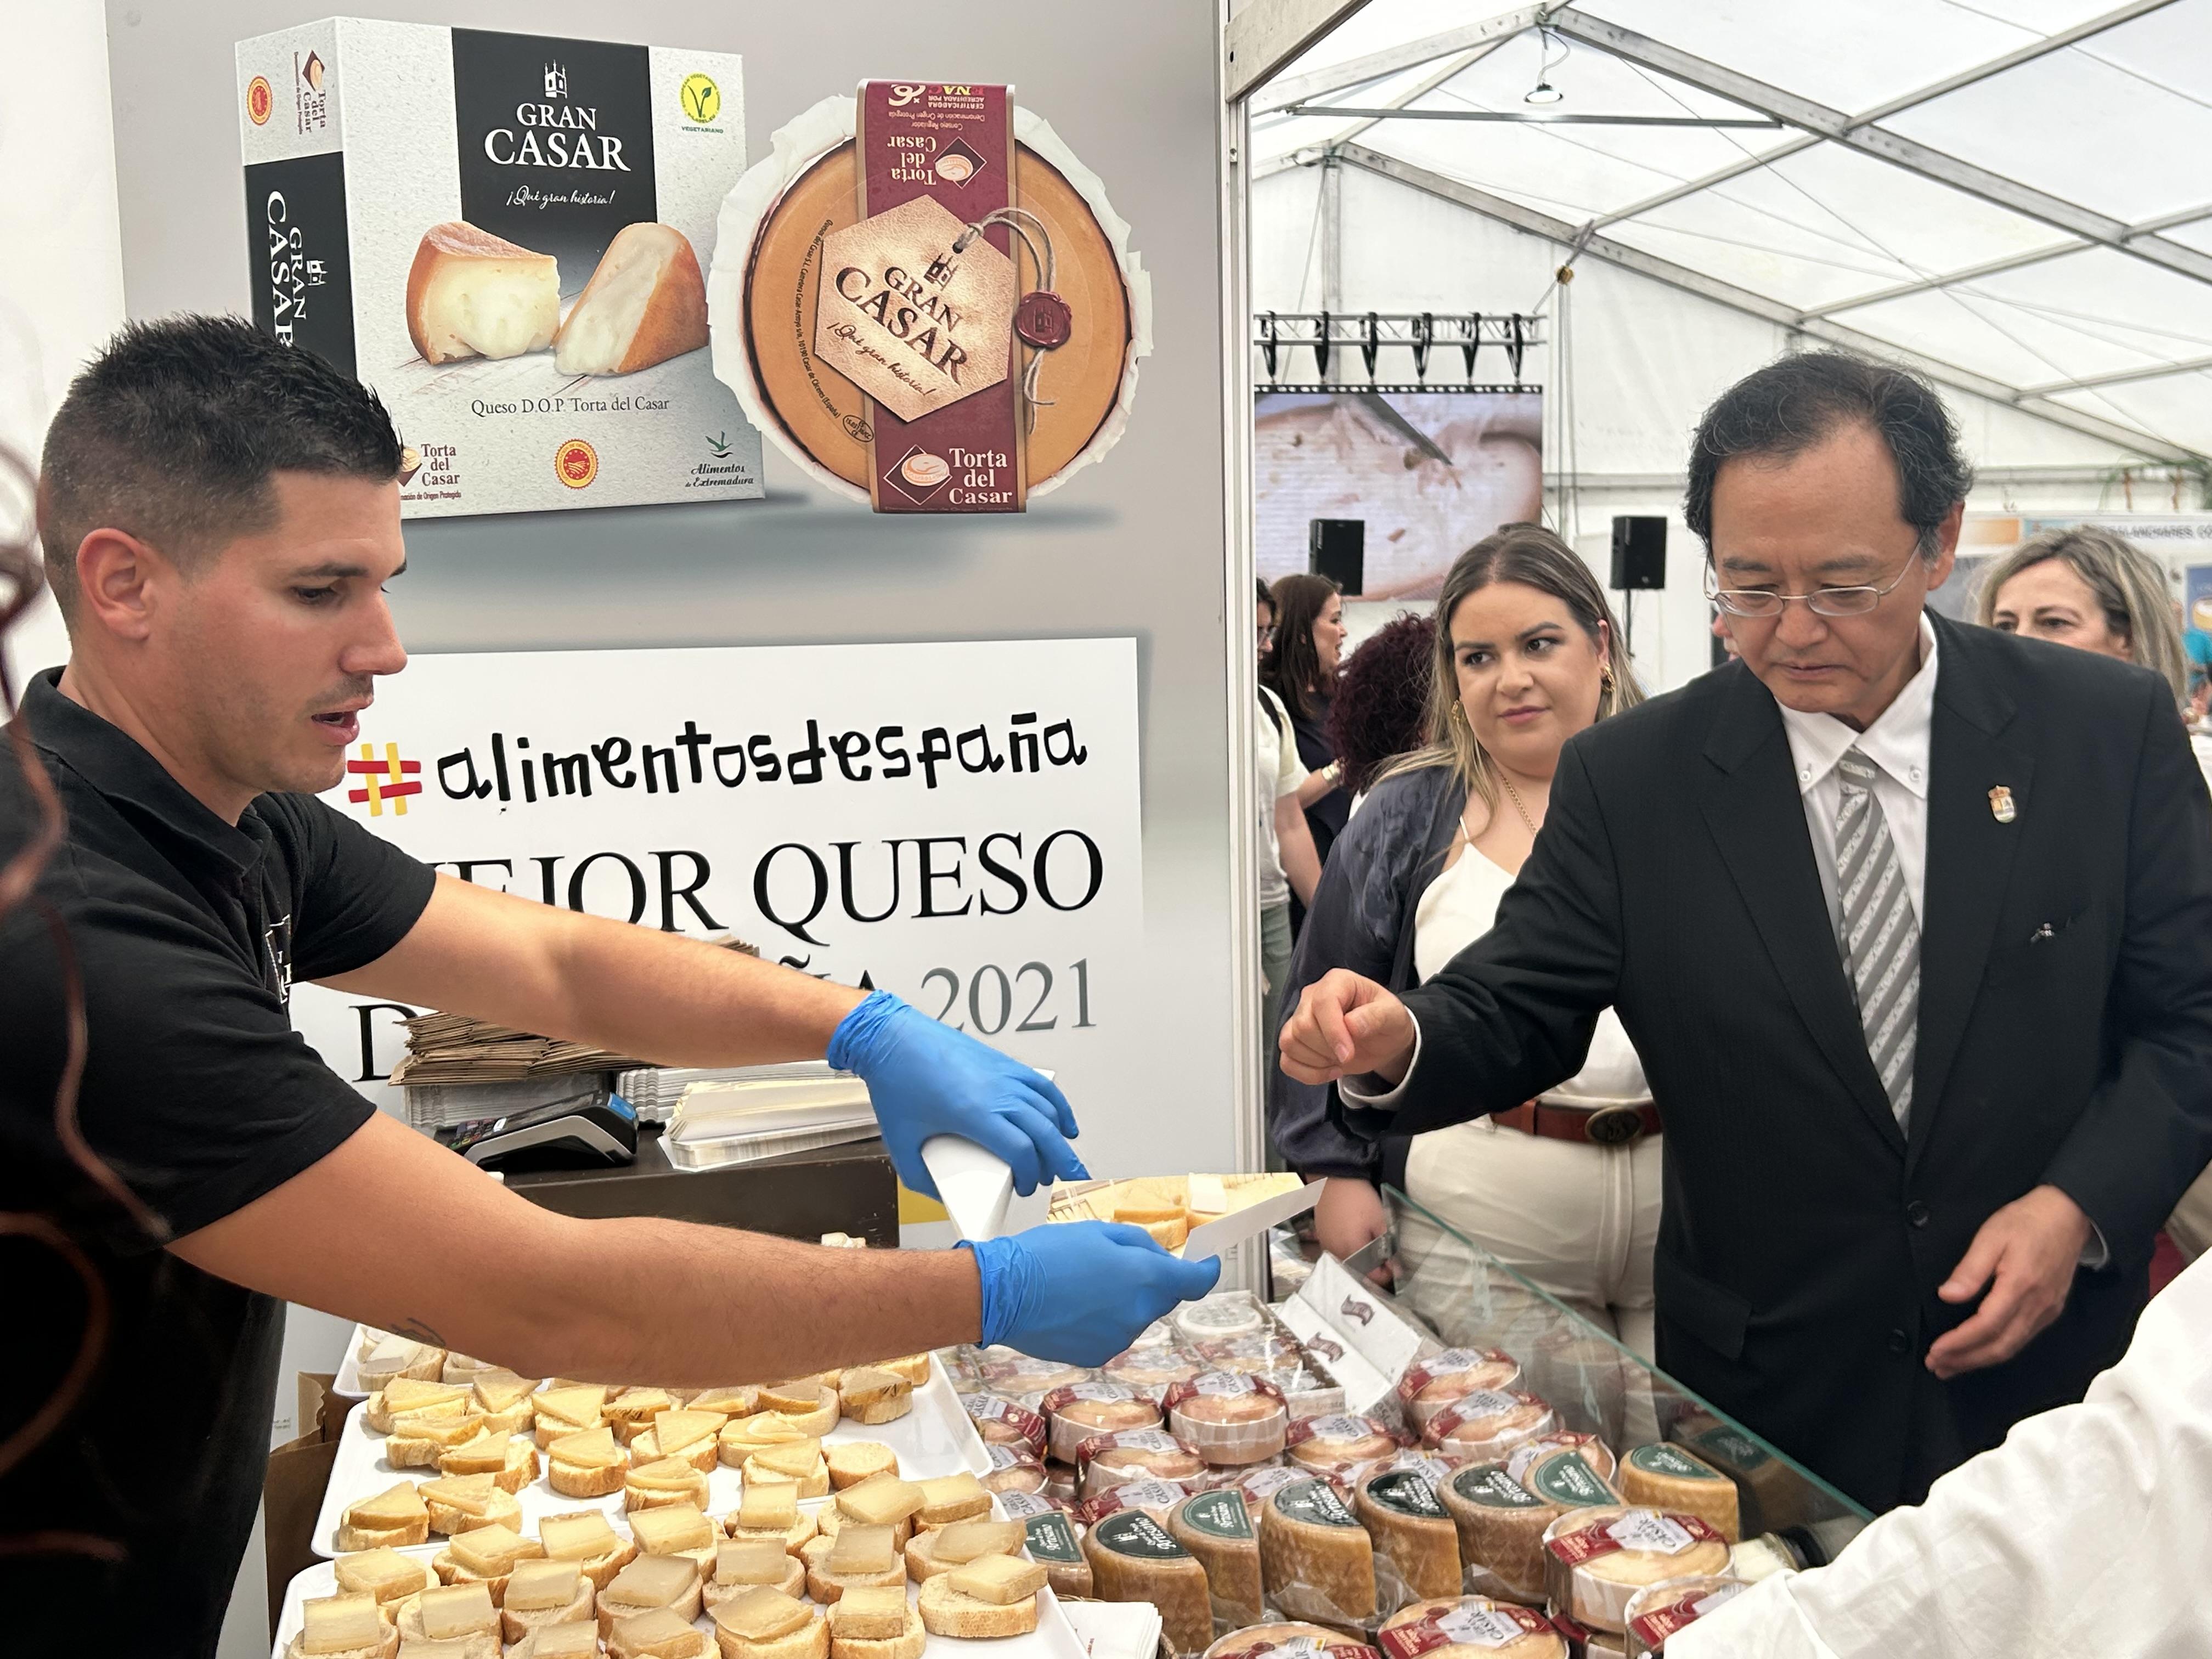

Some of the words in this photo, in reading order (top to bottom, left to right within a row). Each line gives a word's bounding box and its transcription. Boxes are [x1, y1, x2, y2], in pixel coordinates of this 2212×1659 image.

[303, 92, 312, 133] Casar
[516, 102, 596, 131] GRAN
[681, 126, 724, 134] VEGETARIANO
[484, 128, 631, 171] CASAR
[887, 136, 937, 153] Casar
[900, 152, 926, 168] del
[890, 167, 937, 185] Torta
[539, 193, 568, 210] gran
[570, 190, 616, 205] historia!
[289, 226, 307, 320] GRAN
[884, 266, 962, 334] GRAN
[835, 267, 968, 386] CASAR
[855, 346, 888, 366] gran
[471, 399, 517, 417] Queso
[570, 398, 607, 411] Torta
[611, 397, 630, 410] del
[635, 396, 670, 410] Casar
[420, 443, 456, 458] Torta
[949, 448, 1007, 468] Torta
[430, 457, 450, 471] del
[691, 463, 746, 475] Alimentos
[422, 472, 460, 487] Casar
[693, 475, 754, 487] Extremadura
[963, 469, 995, 488] del
[949, 488, 1013, 505] Casar
[753, 830, 1104, 945] QUESO
[921, 958, 1097, 1035] 2021
[1010, 1493, 1036, 1515] CASAR
[1041, 1524, 1062, 1551] Artesano
[1135, 1517, 1177, 1549] Artesano
[1470, 1611, 1505, 1640] CASAR
